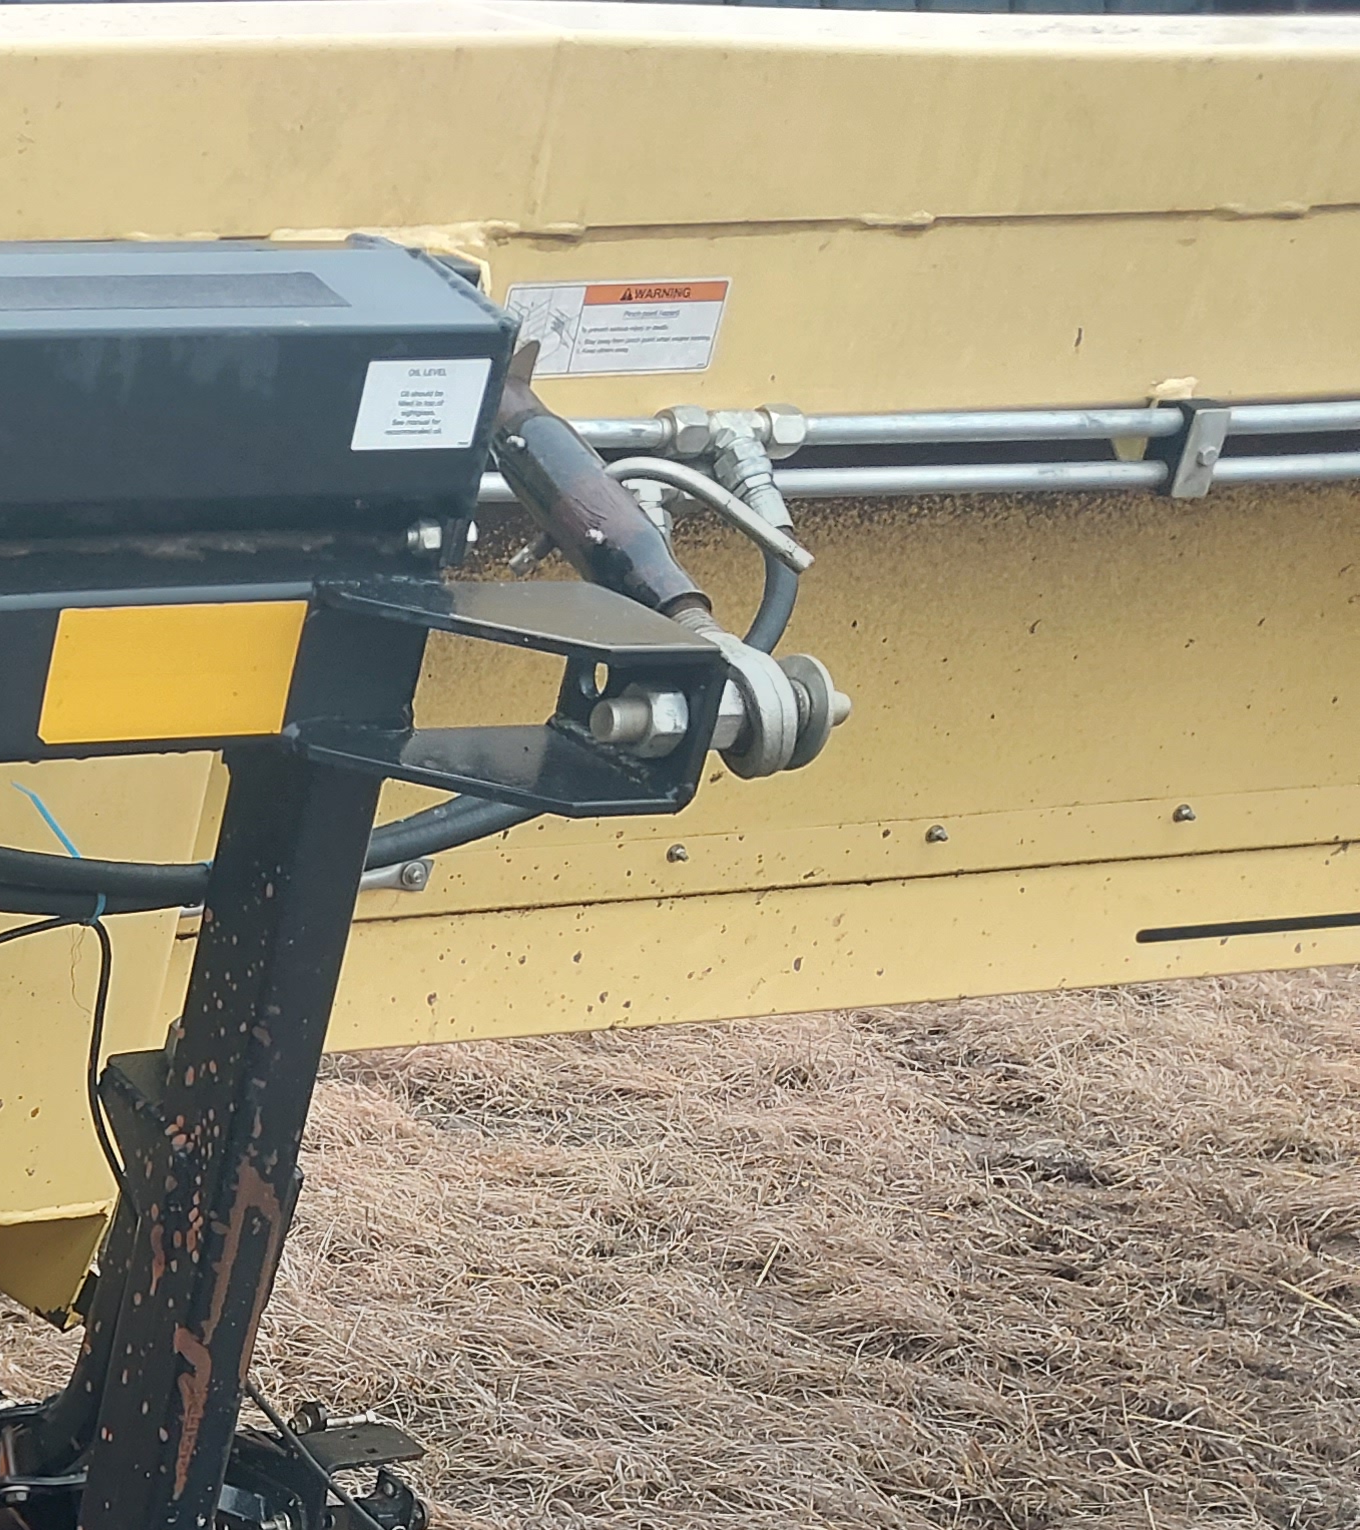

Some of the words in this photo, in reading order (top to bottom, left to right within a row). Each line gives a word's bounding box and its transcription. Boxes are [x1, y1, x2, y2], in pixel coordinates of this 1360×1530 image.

[634, 287, 691, 299] WARNING
[408, 368, 421, 377] OIL
[423, 368, 447, 376] LEVEL
